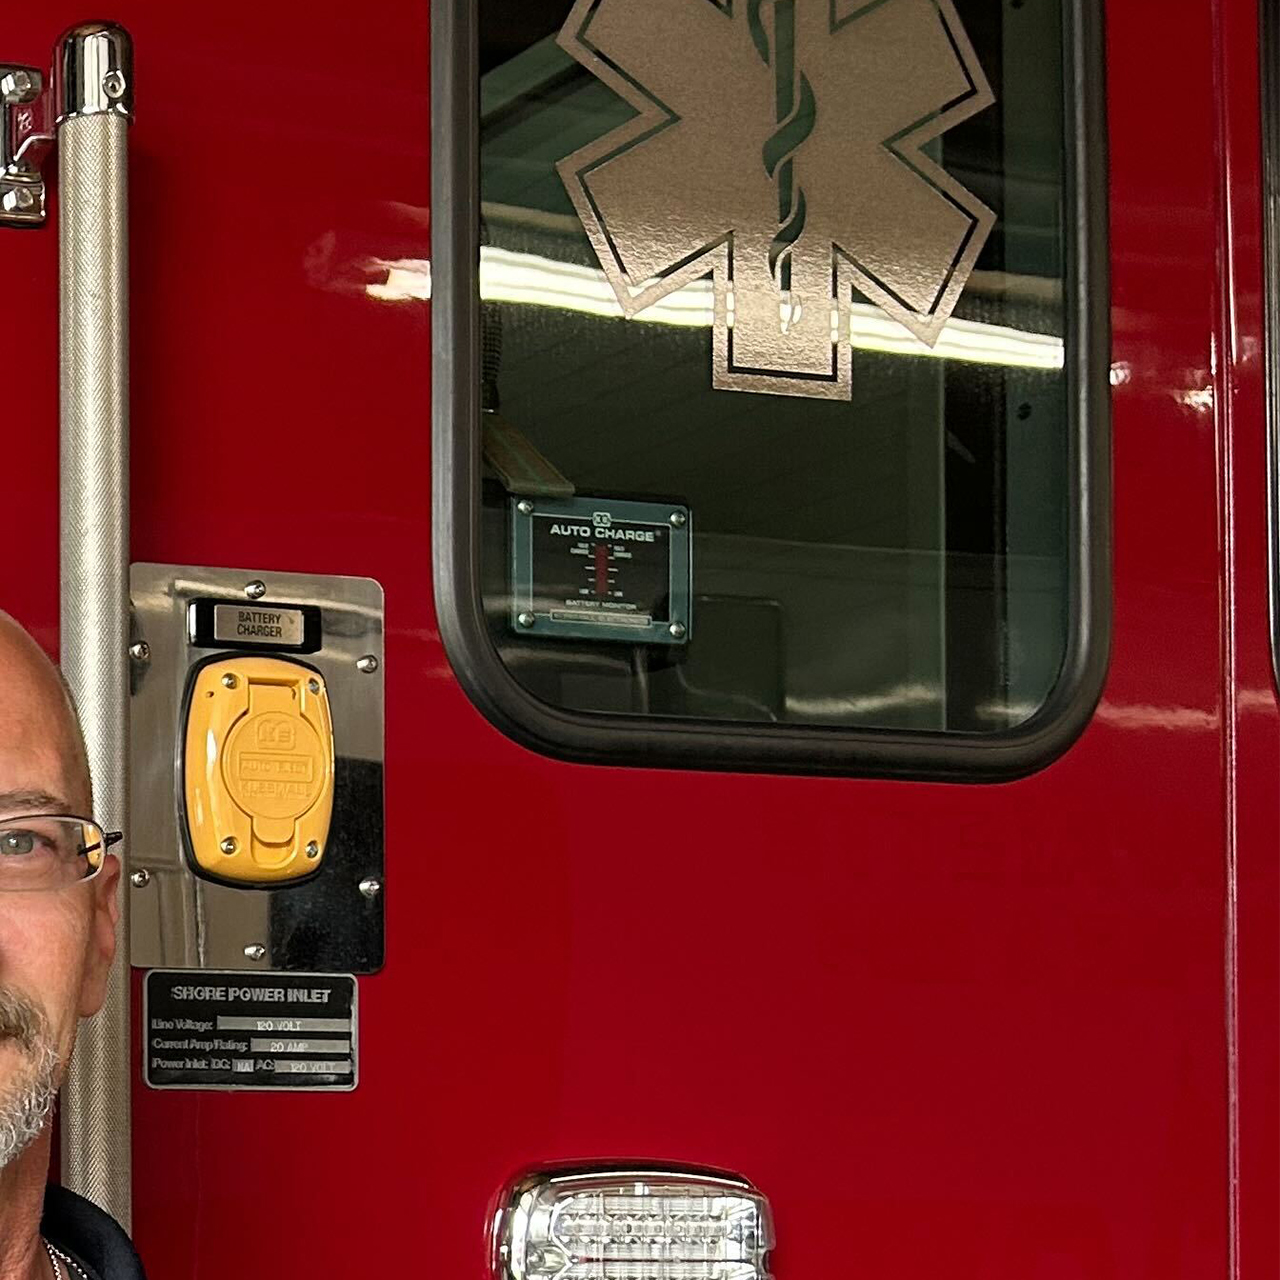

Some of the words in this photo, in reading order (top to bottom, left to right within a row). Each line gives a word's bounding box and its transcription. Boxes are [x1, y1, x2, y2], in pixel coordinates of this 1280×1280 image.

[549, 524, 591, 538] AUTO
[594, 528, 655, 543] CHARGE
[565, 599, 600, 608] BATTERY
[601, 601, 637, 610] MONITOR
[238, 610, 282, 625] BATTERY
[236, 622, 283, 639] CHARGER
[172, 985, 227, 1001] SHORE
[228, 987, 285, 1002] POWER
[287, 988, 332, 1003] INLET
[276, 1020, 302, 1031] VOLT
[270, 1042, 284, 1052] 20
[151, 1058, 185, 1069] Power
